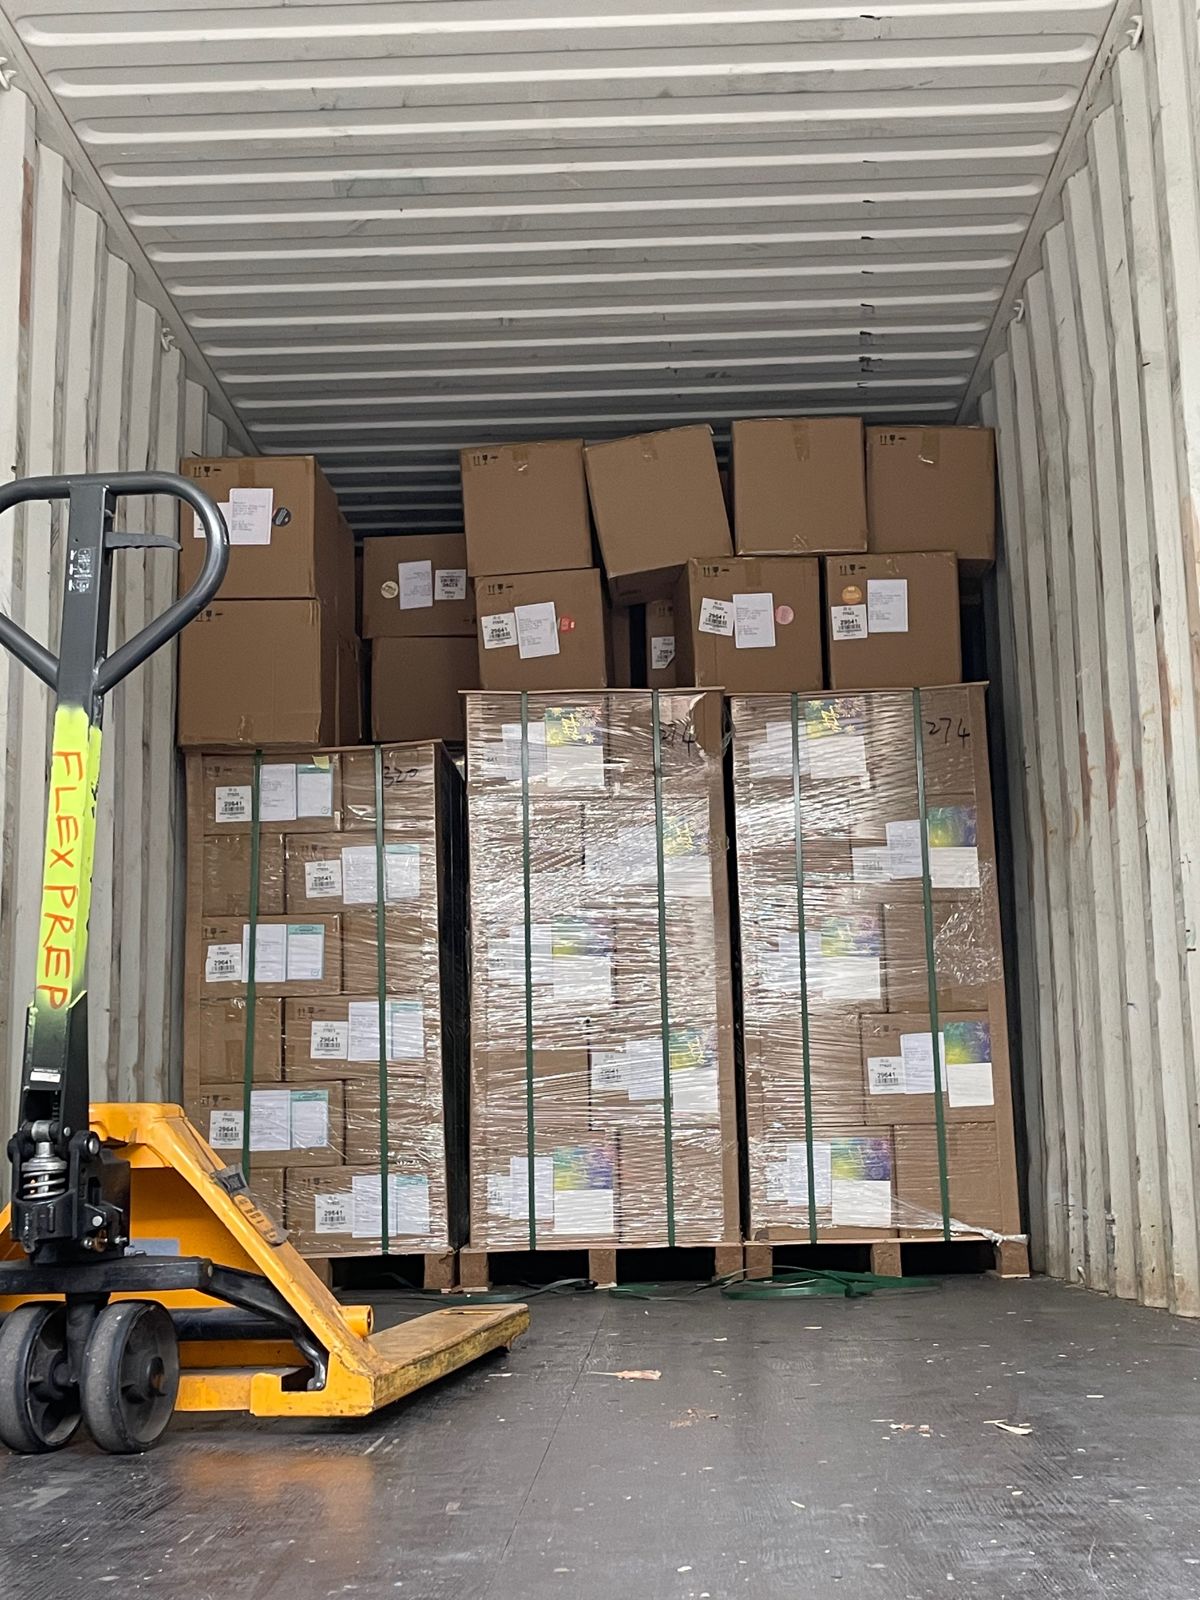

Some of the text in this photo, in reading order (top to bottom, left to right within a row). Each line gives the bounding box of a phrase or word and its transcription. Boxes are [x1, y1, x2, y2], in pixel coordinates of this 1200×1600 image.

[925, 718, 970, 748] 274
[37, 750, 85, 1010] FLEX PREP
